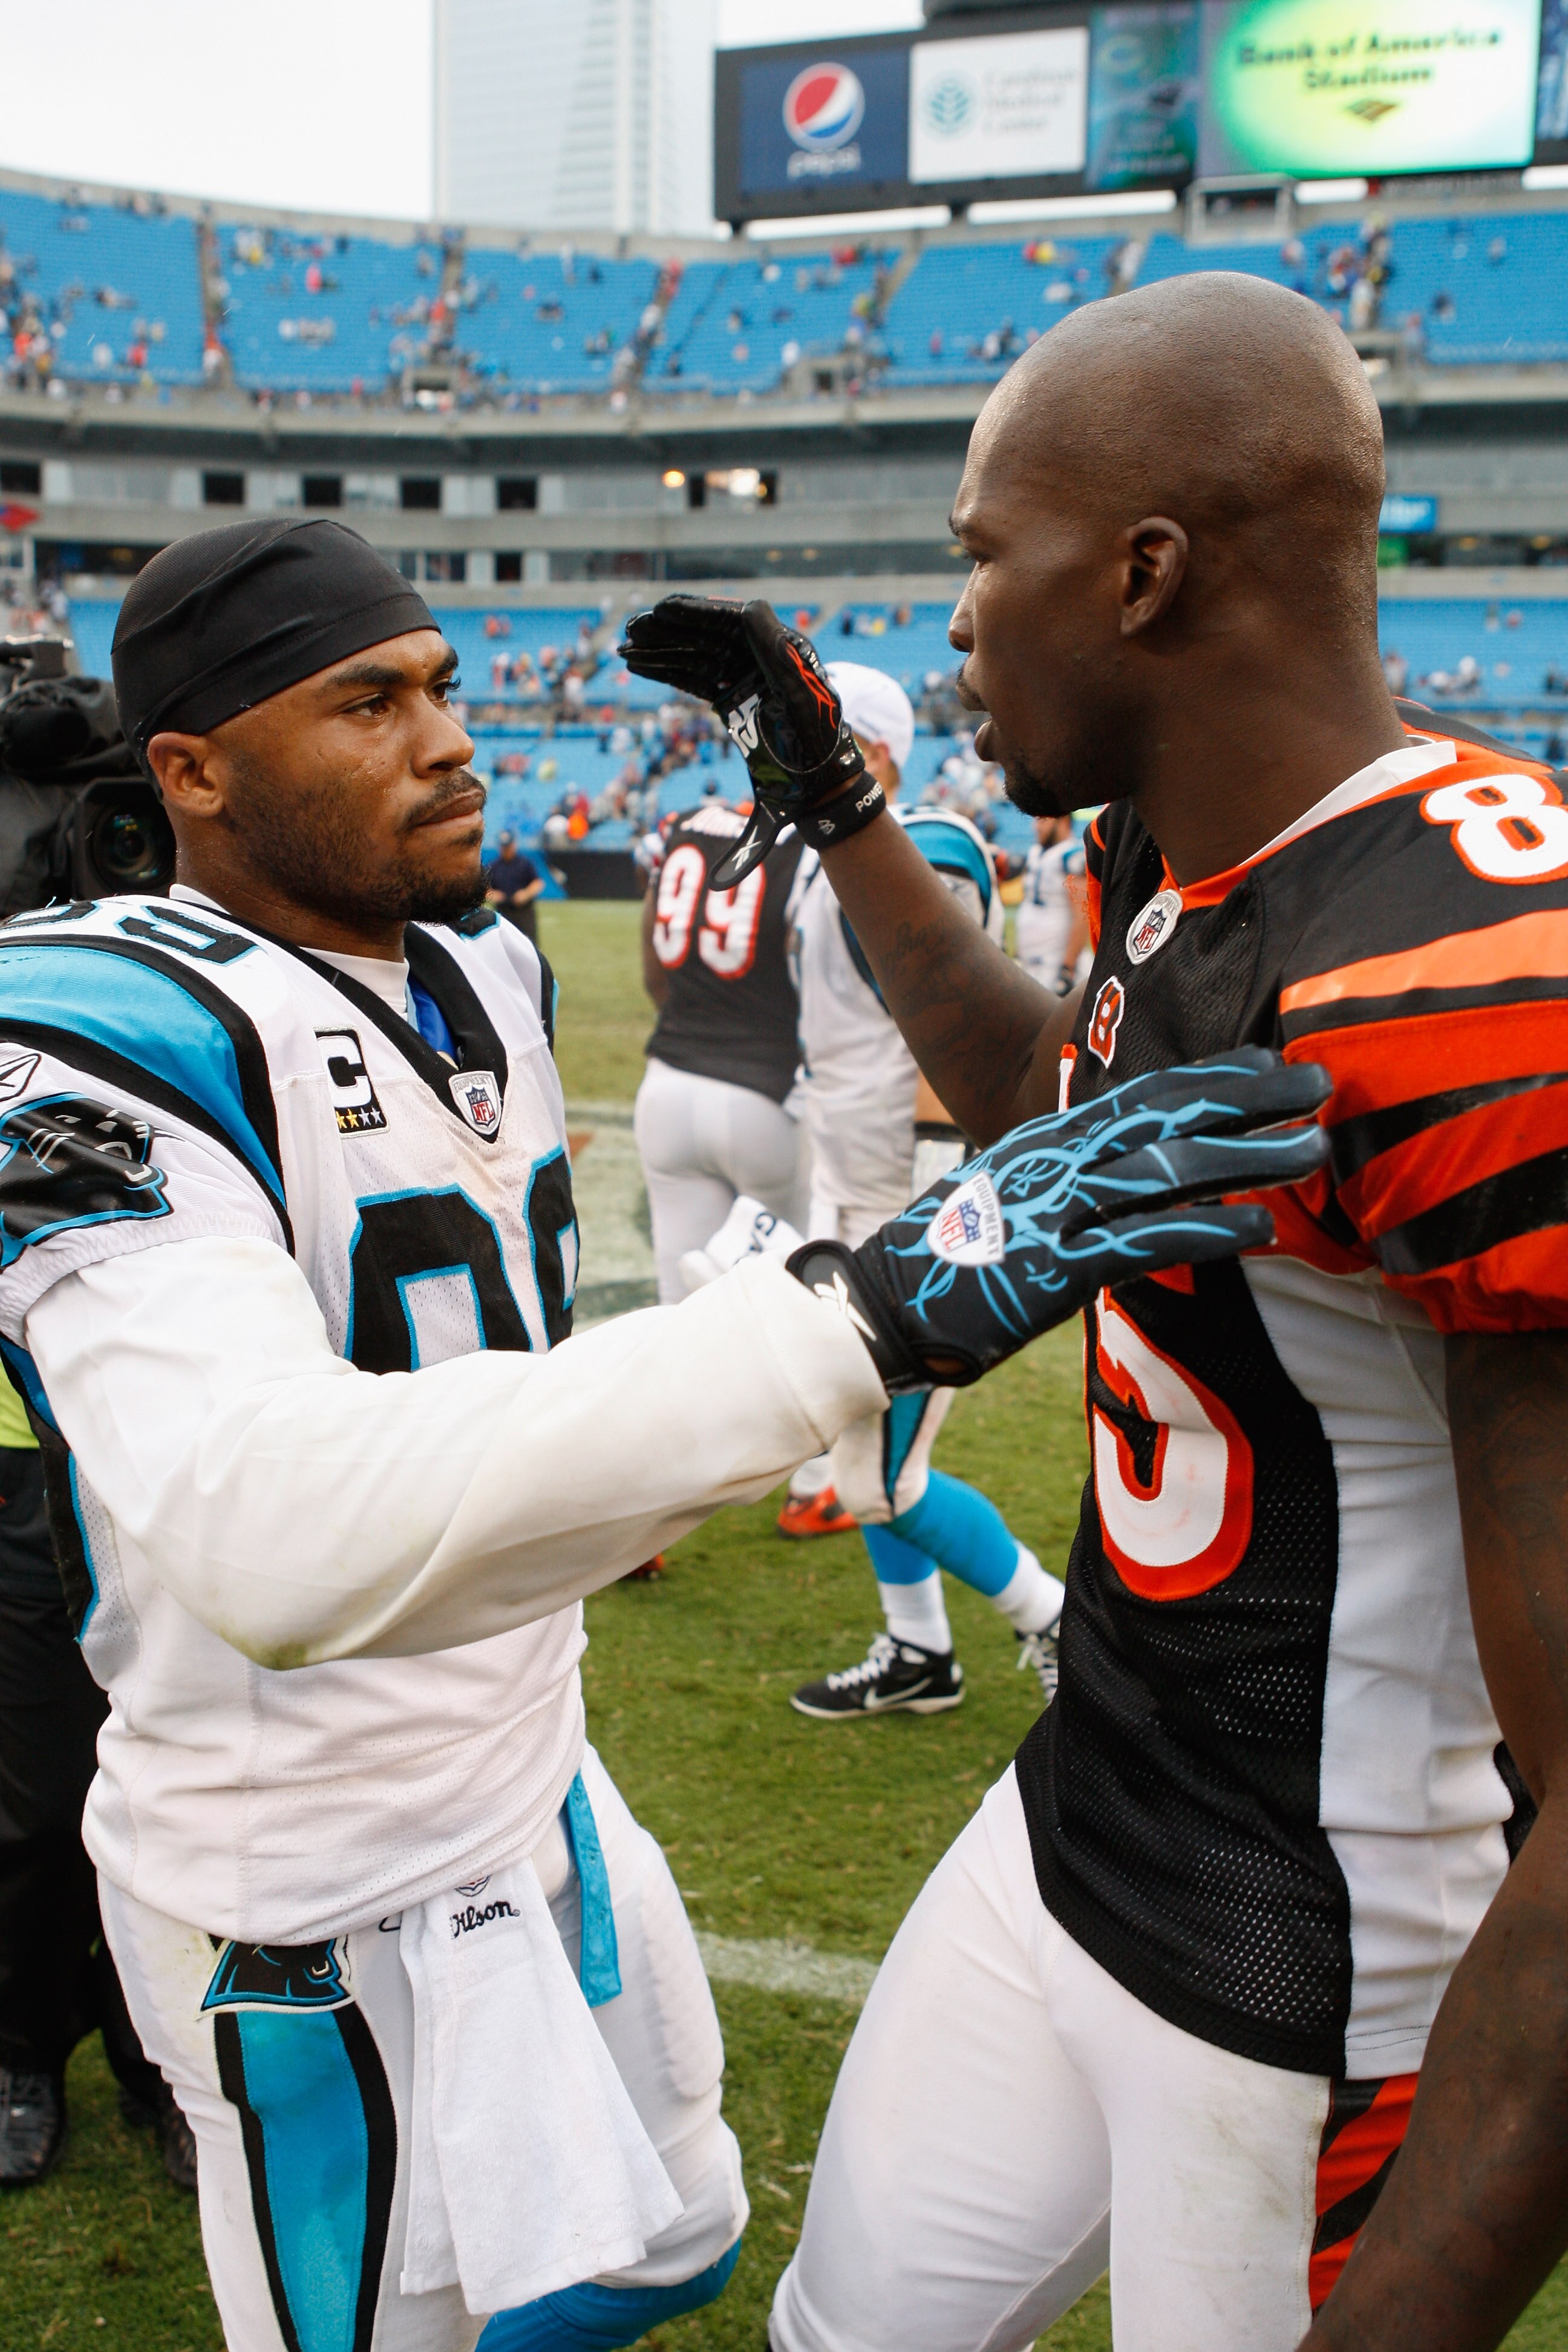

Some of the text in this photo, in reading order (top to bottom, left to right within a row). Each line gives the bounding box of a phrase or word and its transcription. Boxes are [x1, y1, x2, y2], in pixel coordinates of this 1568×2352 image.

[1240, 29, 1500, 65] Bank of America
[1305, 68, 1431, 89] Stadium
[652, 843, 767, 981] 99
[315, 1033, 373, 1109] C
[471, 1101, 495, 1122] NFL
[939, 1208, 966, 1252] NFL
[973, 1177, 999, 1256] EQUIPMENT
